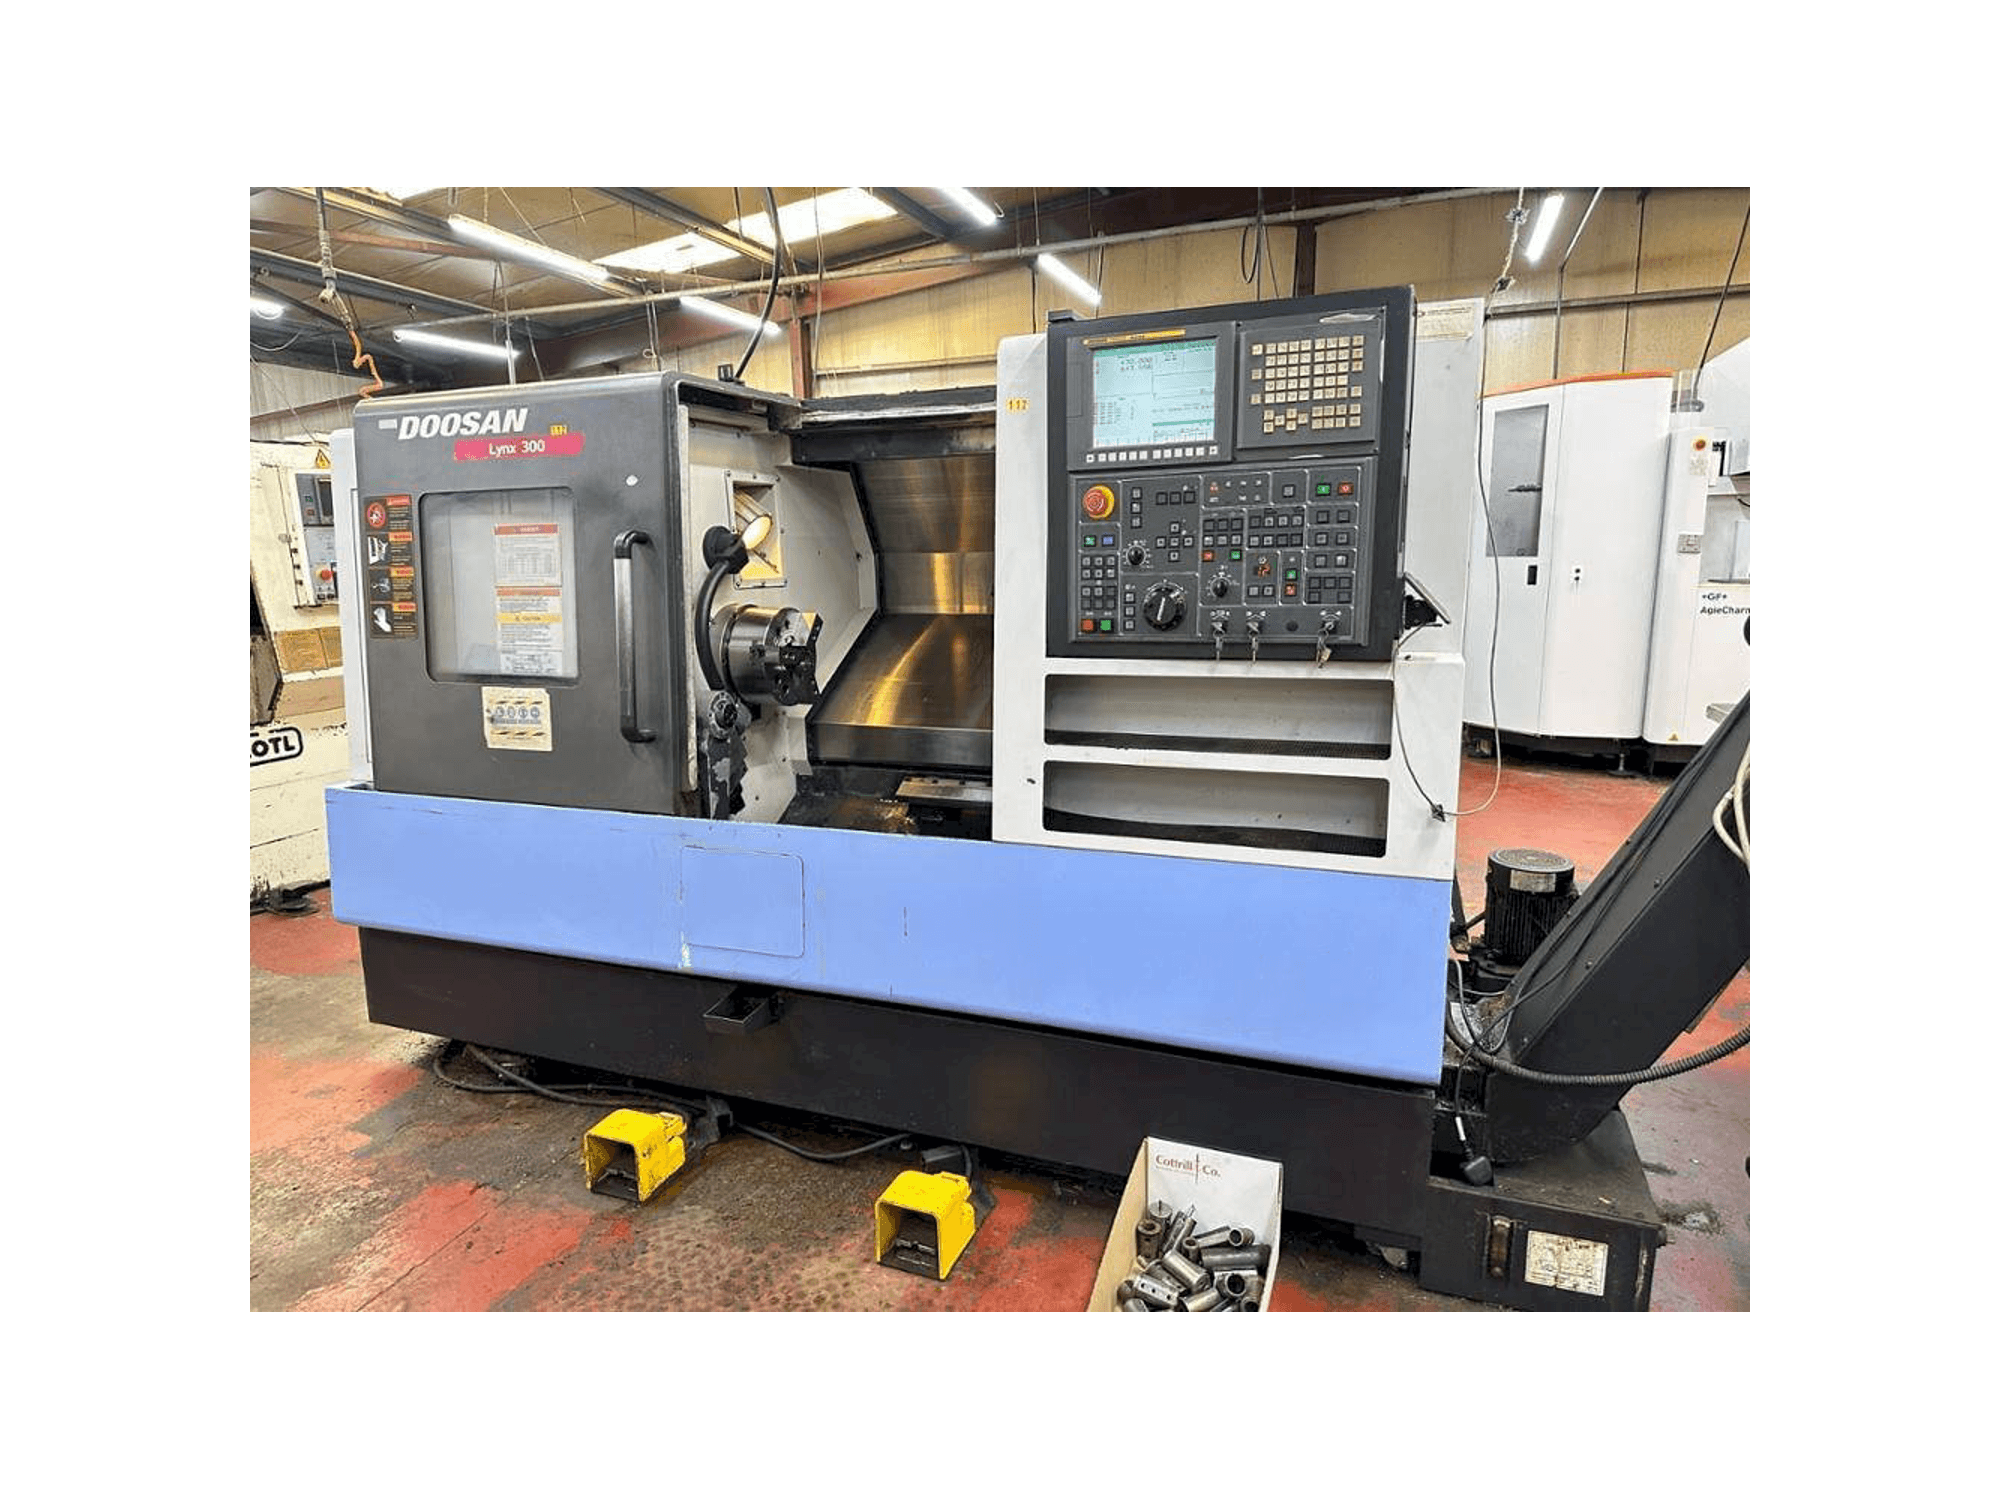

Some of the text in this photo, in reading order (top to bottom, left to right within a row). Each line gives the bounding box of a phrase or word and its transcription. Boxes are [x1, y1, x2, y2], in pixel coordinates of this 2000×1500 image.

[398, 407, 528, 440] DOOSAN
[488, 439, 546, 458] Lynx 300
[250, 735, 296, 758] OTL
[1155, 1154, 1193, 1171] Cottrill
[1202, 1164, 1221, 1177] Co.
